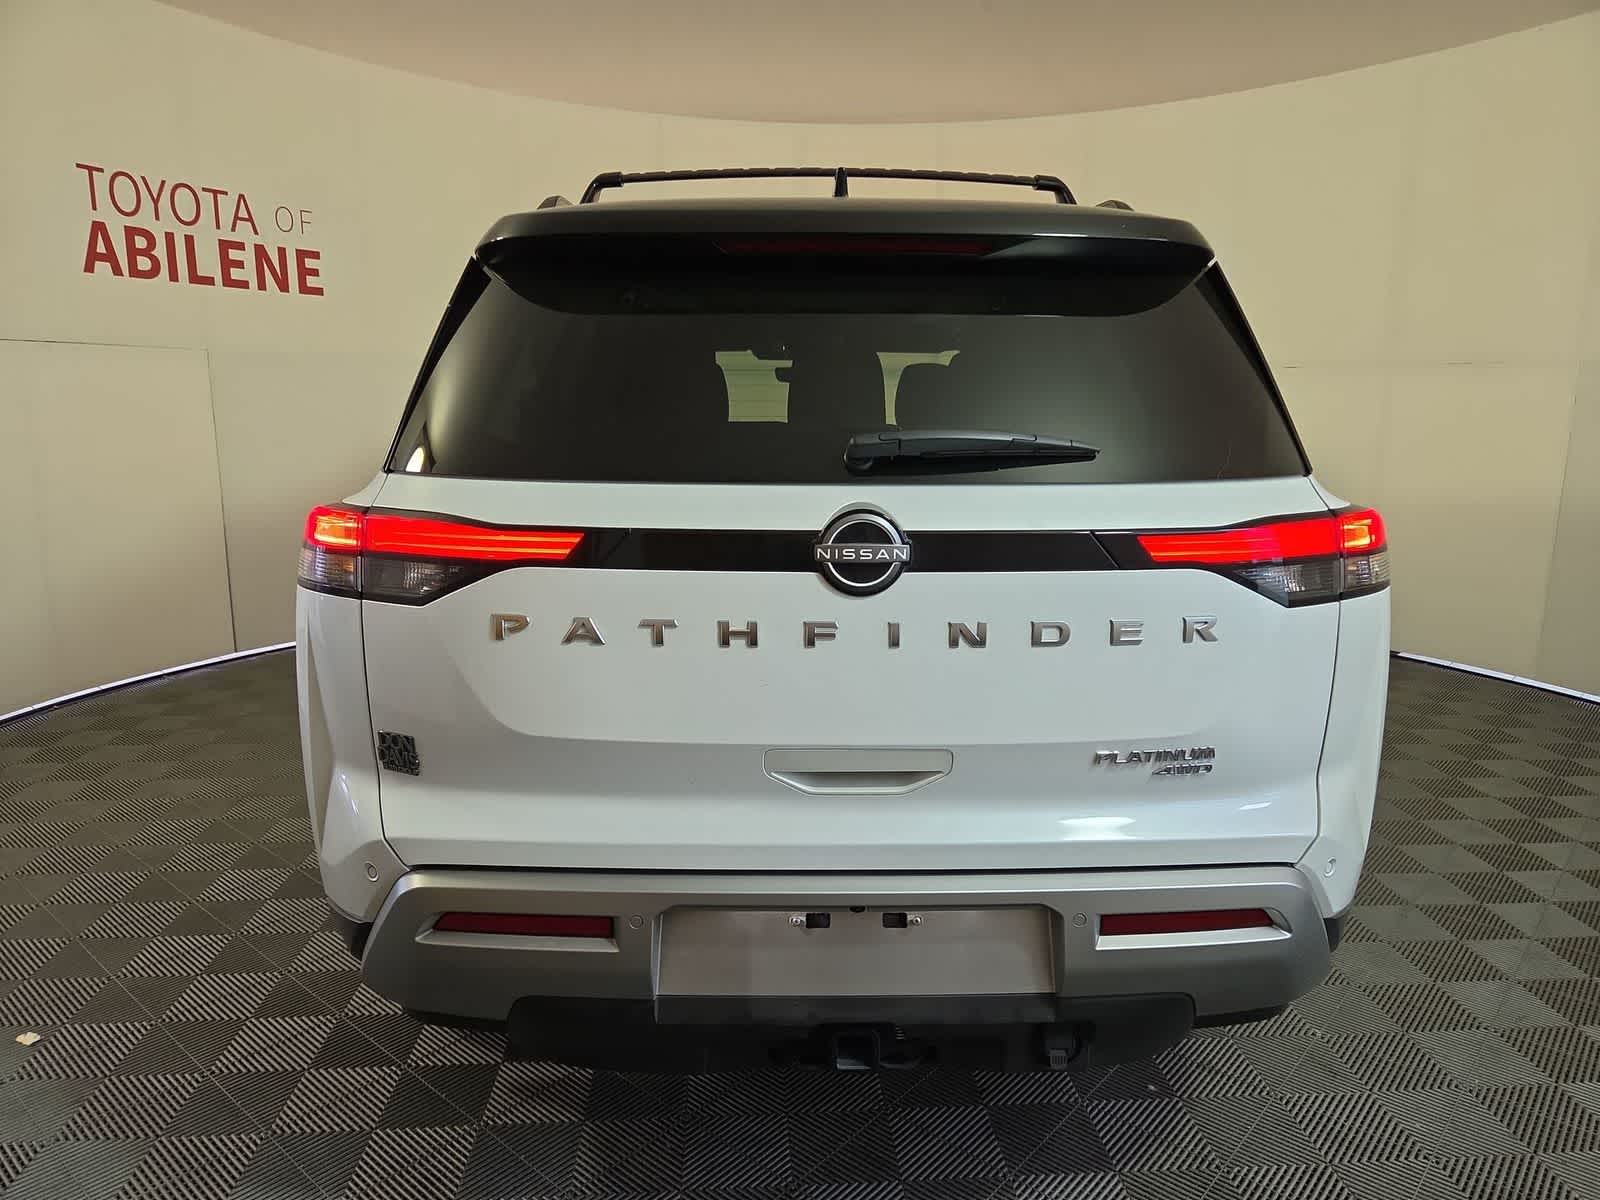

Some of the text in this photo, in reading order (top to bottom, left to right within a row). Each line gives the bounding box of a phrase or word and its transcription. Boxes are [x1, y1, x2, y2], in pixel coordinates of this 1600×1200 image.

[75, 162, 313, 236] TOYOTA OF
[83, 219, 325, 297] ABILENE
[816, 547, 908, 560] NISSAN
[490, 612, 1219, 648] PATHFINDER
[1093, 746, 1216, 765] PLATINUM
